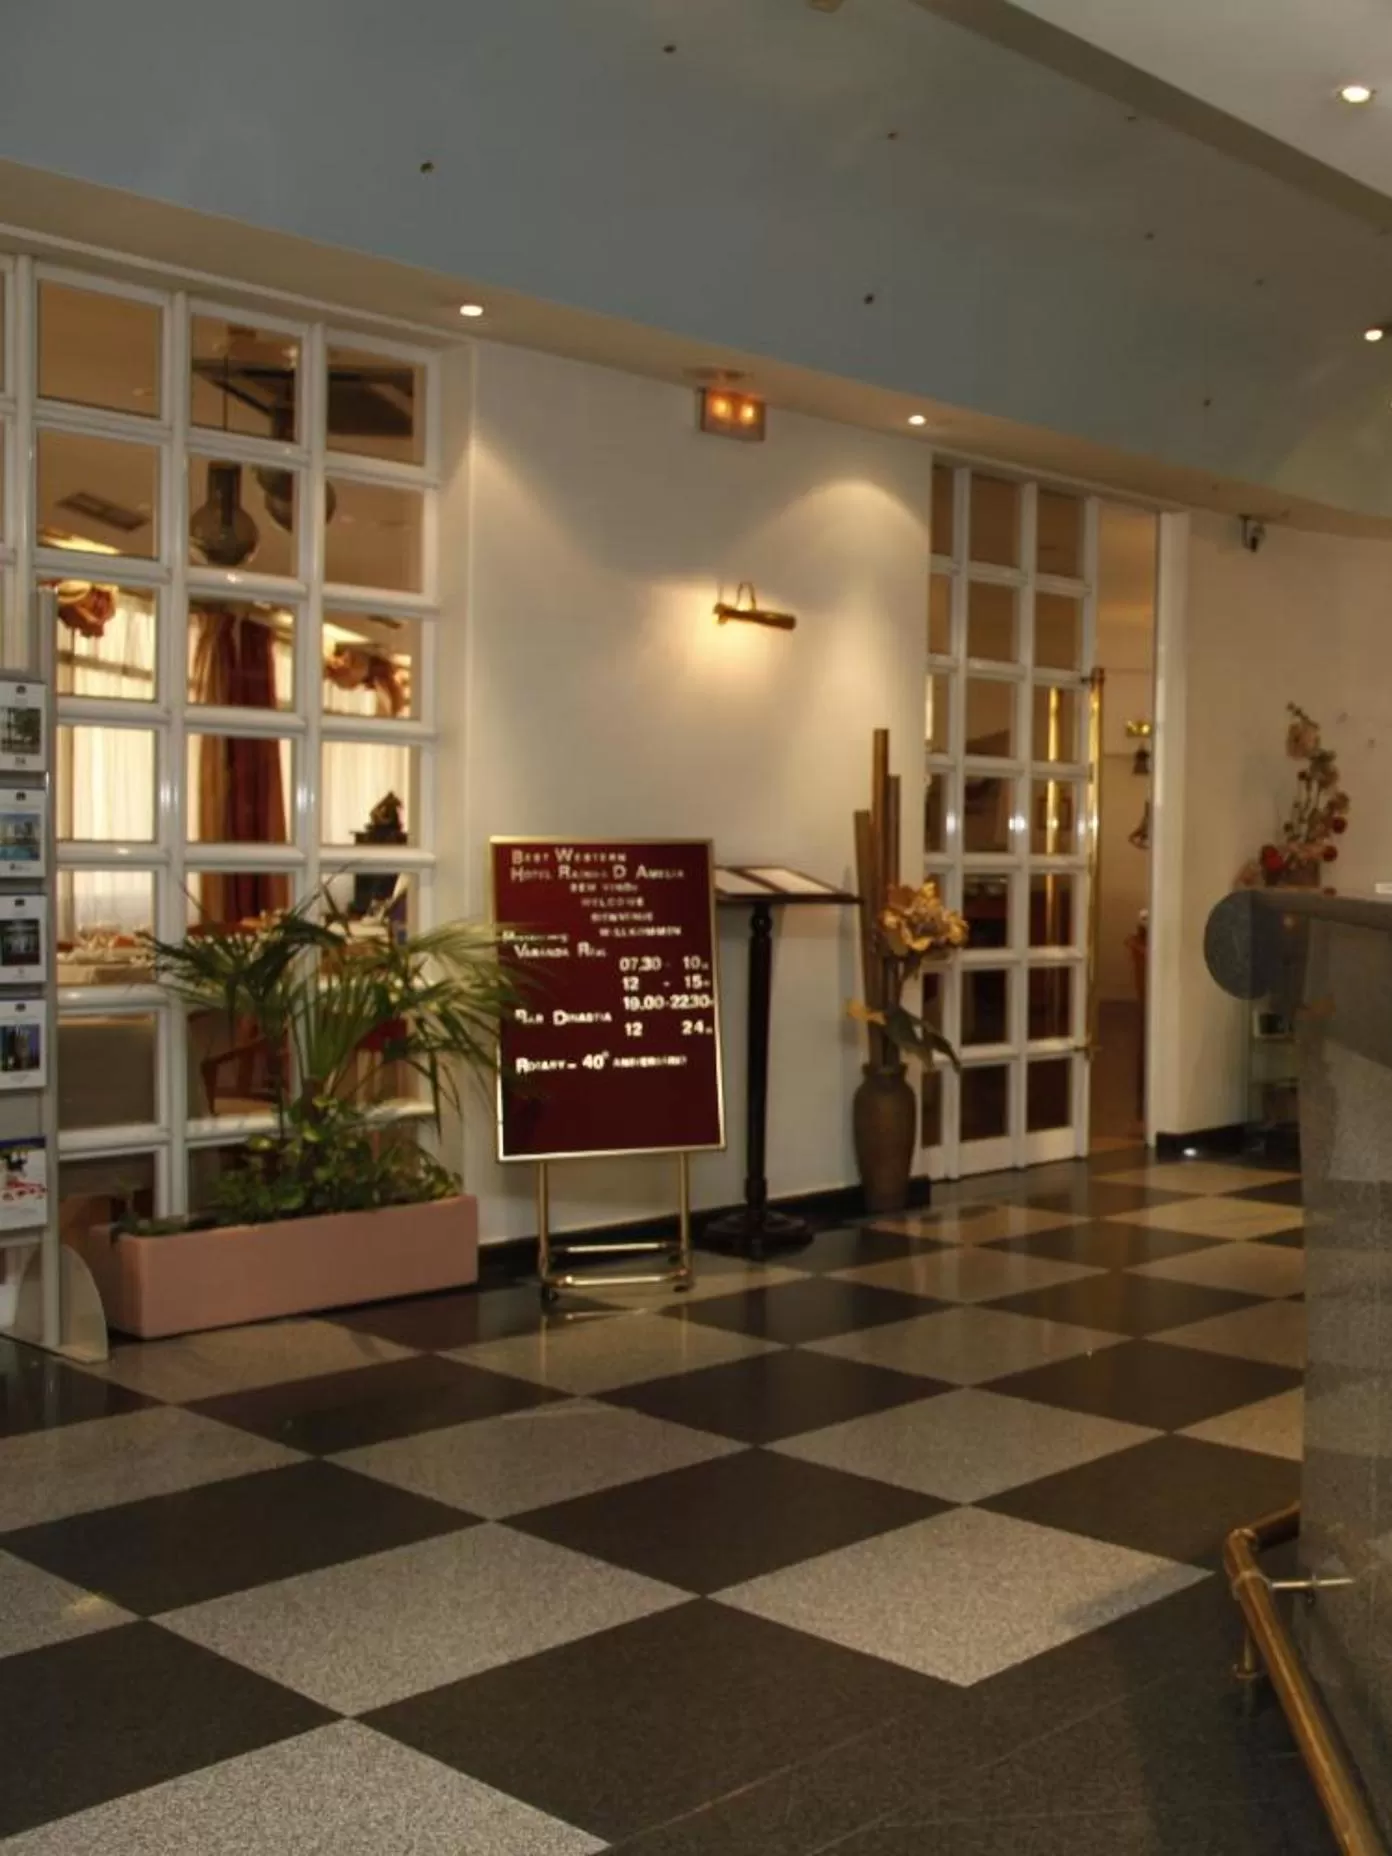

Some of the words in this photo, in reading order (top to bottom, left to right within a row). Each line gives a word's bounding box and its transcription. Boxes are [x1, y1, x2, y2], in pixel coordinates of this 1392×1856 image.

[511, 848, 550, 865] BEST
[554, 847, 627, 863] WESTERN
[510, 865, 552, 882] HOTEL
[622, 975, 641, 992] 12
[624, 1021, 644, 1038] 12
[514, 1056, 566, 1076] ROTARY
